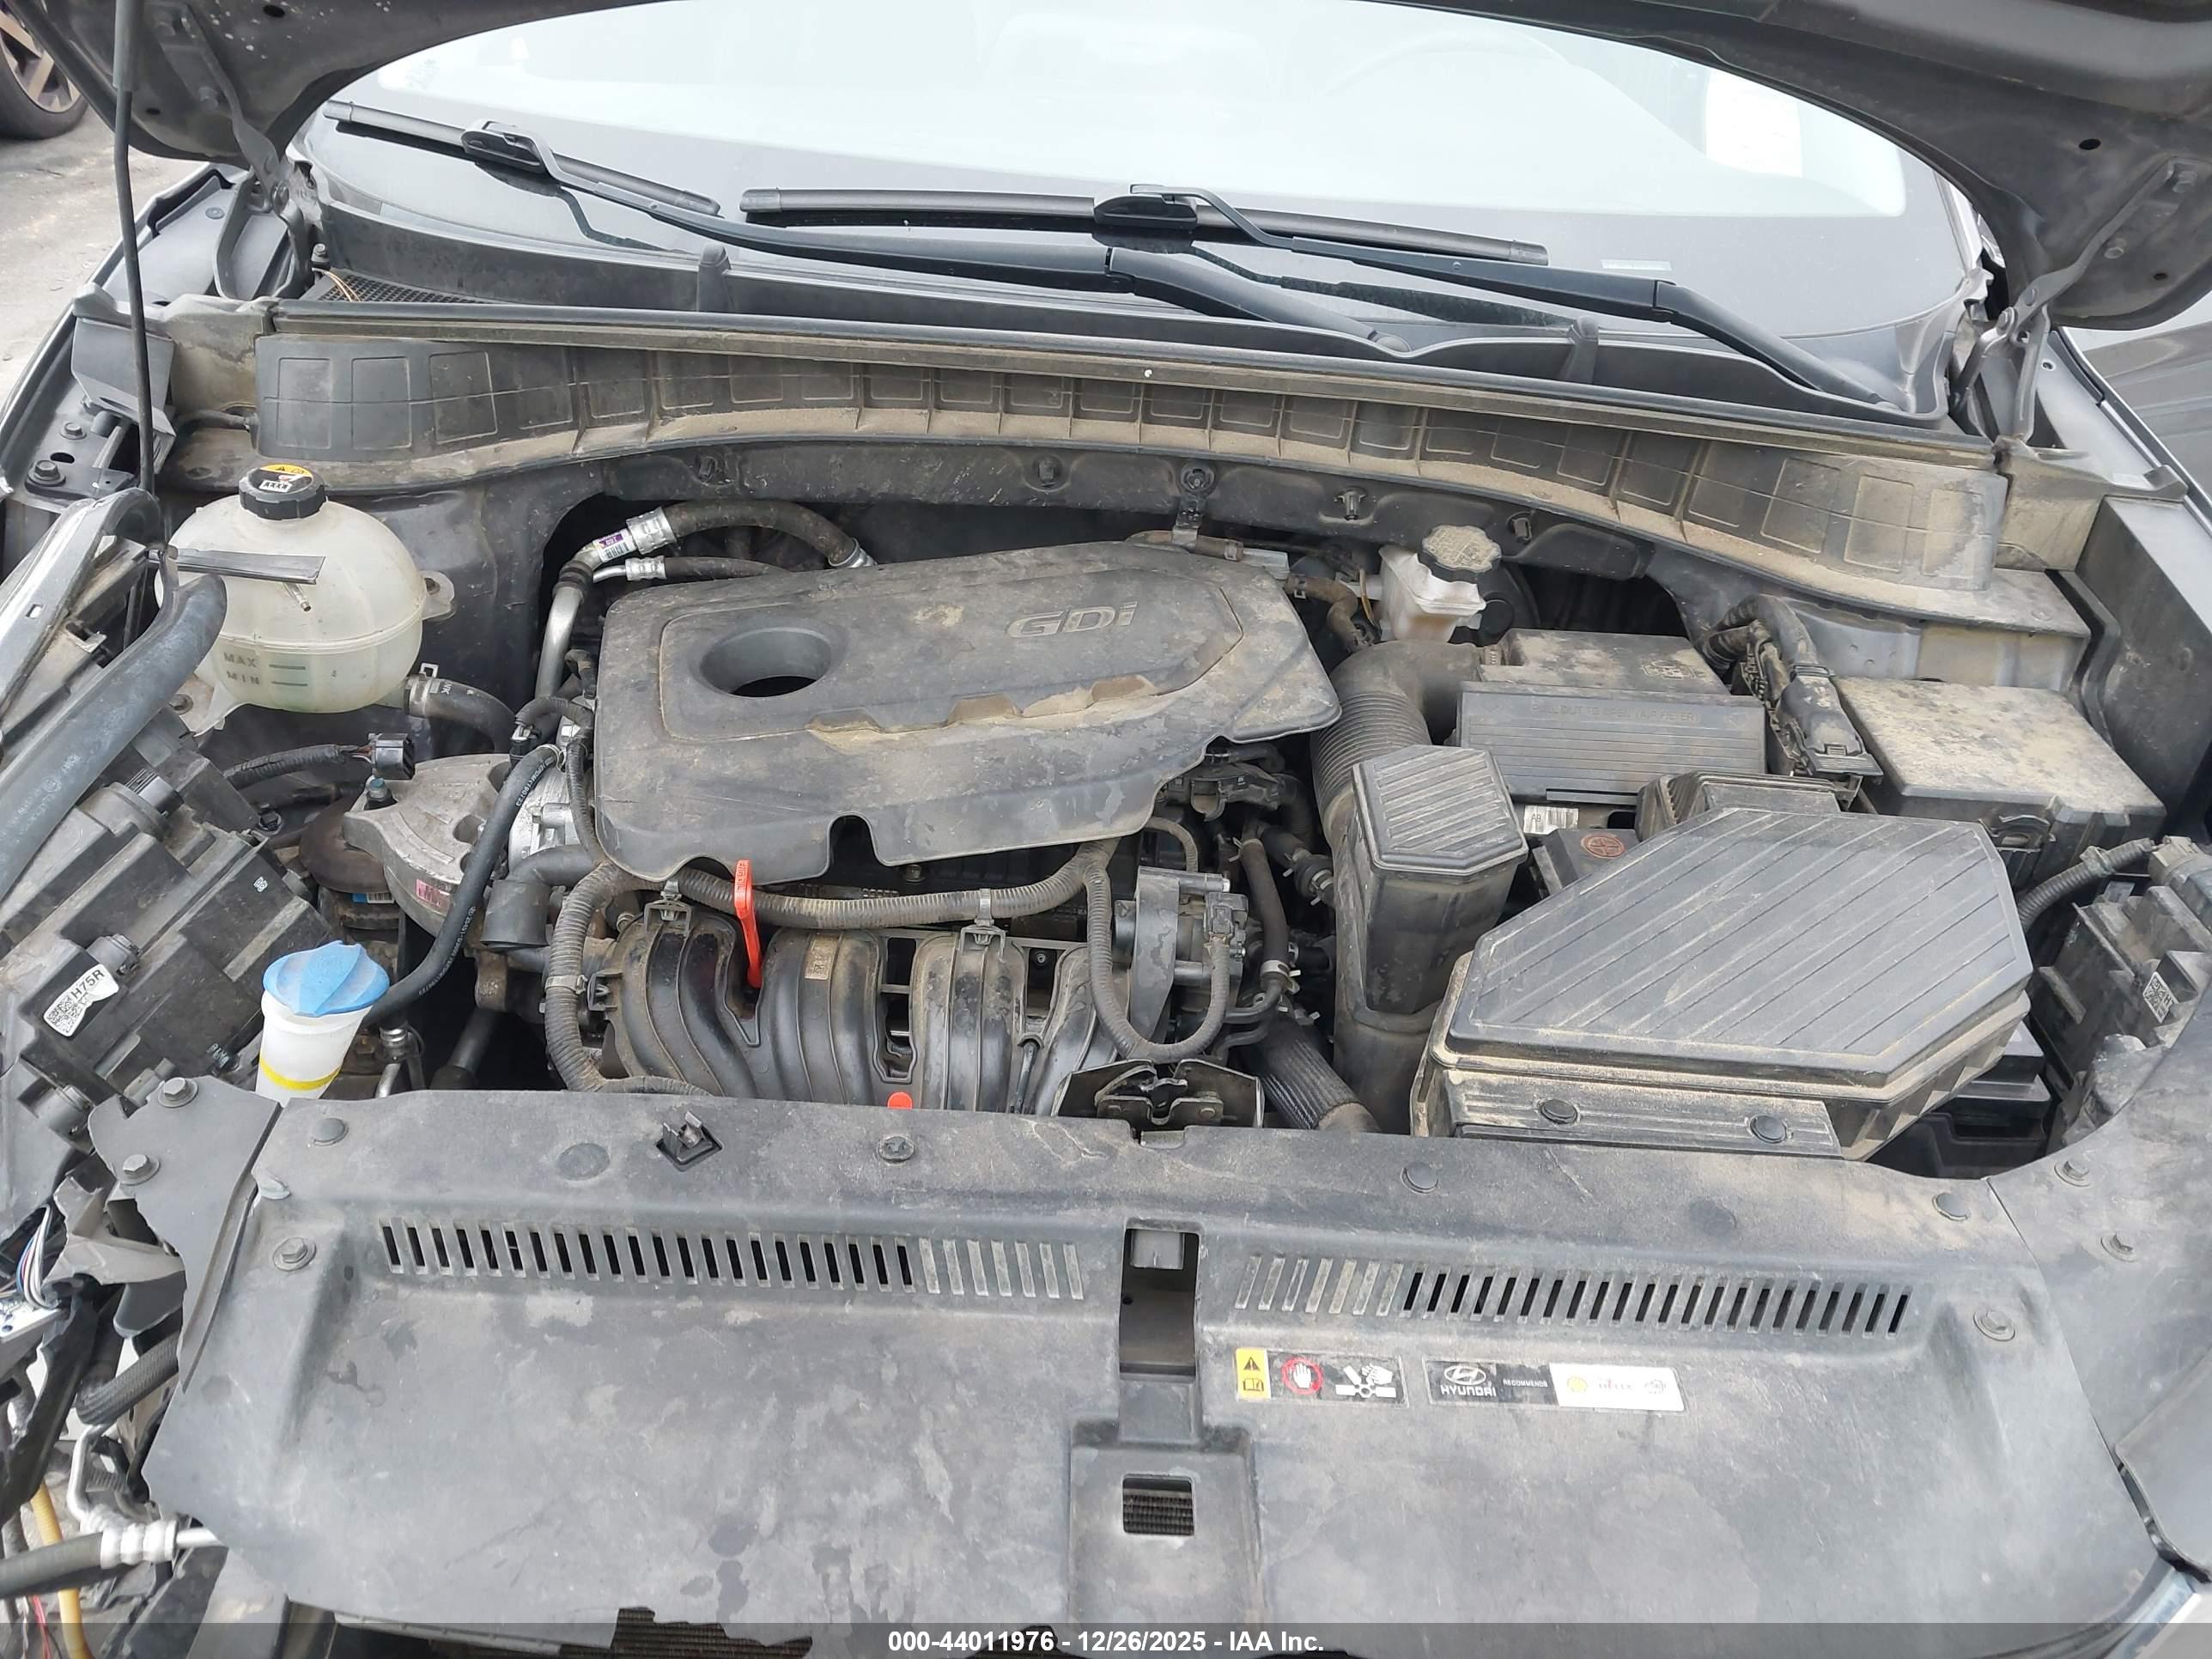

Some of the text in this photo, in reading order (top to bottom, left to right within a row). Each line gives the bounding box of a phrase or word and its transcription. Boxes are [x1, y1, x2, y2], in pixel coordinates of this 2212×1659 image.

[1006, 601, 1138, 638] GDi
[223, 653, 257, 668] MAX
[226, 671, 259, 685] MIN
[70, 969, 105, 1000] H75R
[1440, 1384, 1497, 1397] HYUNDAI
